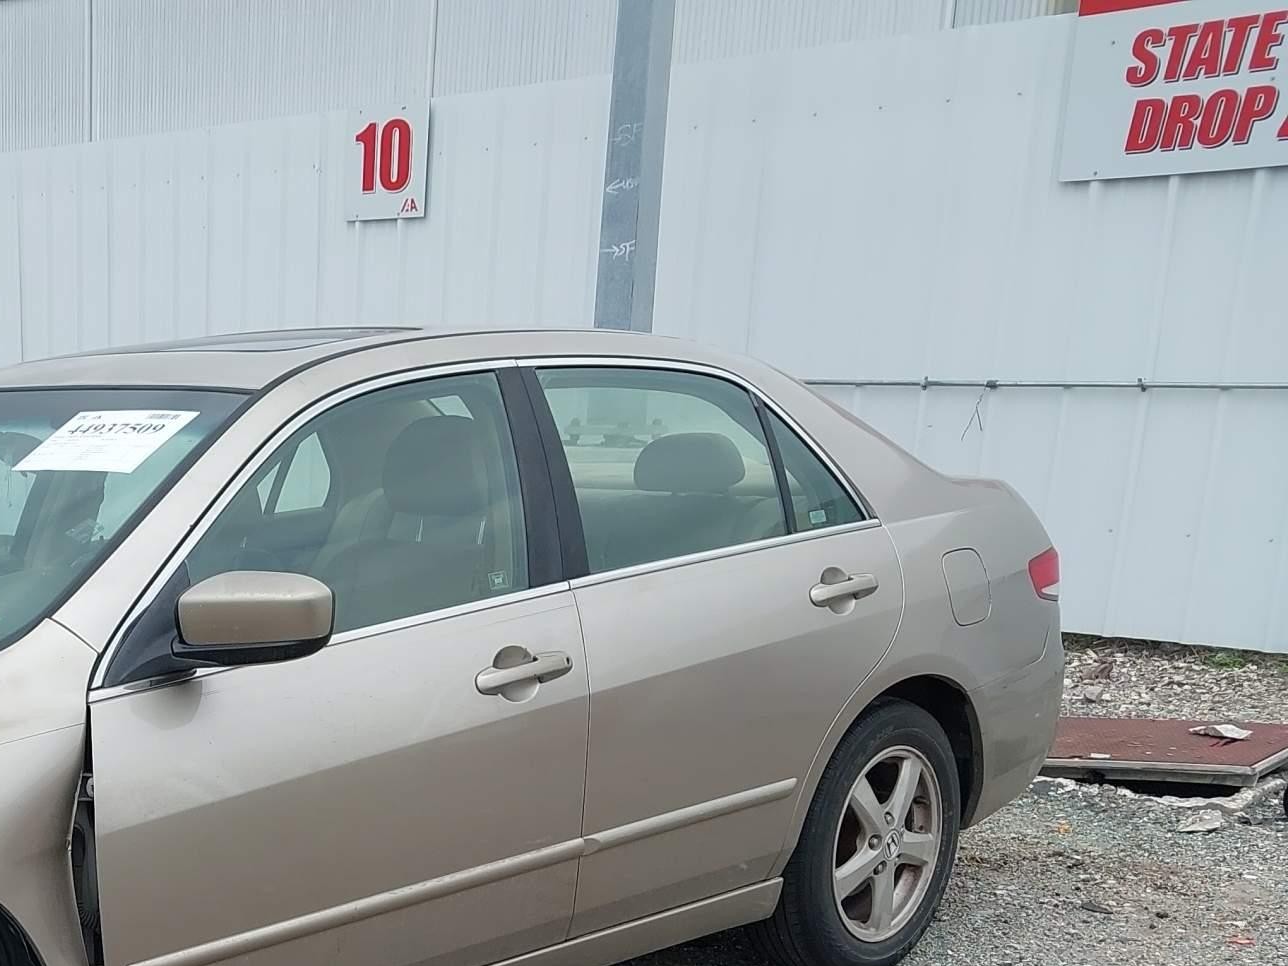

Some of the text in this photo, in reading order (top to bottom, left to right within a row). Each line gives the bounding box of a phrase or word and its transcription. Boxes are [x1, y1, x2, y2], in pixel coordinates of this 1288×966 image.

[1125, 10, 1288, 87] STATE
[354, 117, 413, 194] 10
[1125, 84, 1280, 155] DROP
[68, 423, 166, 435] 44937509
